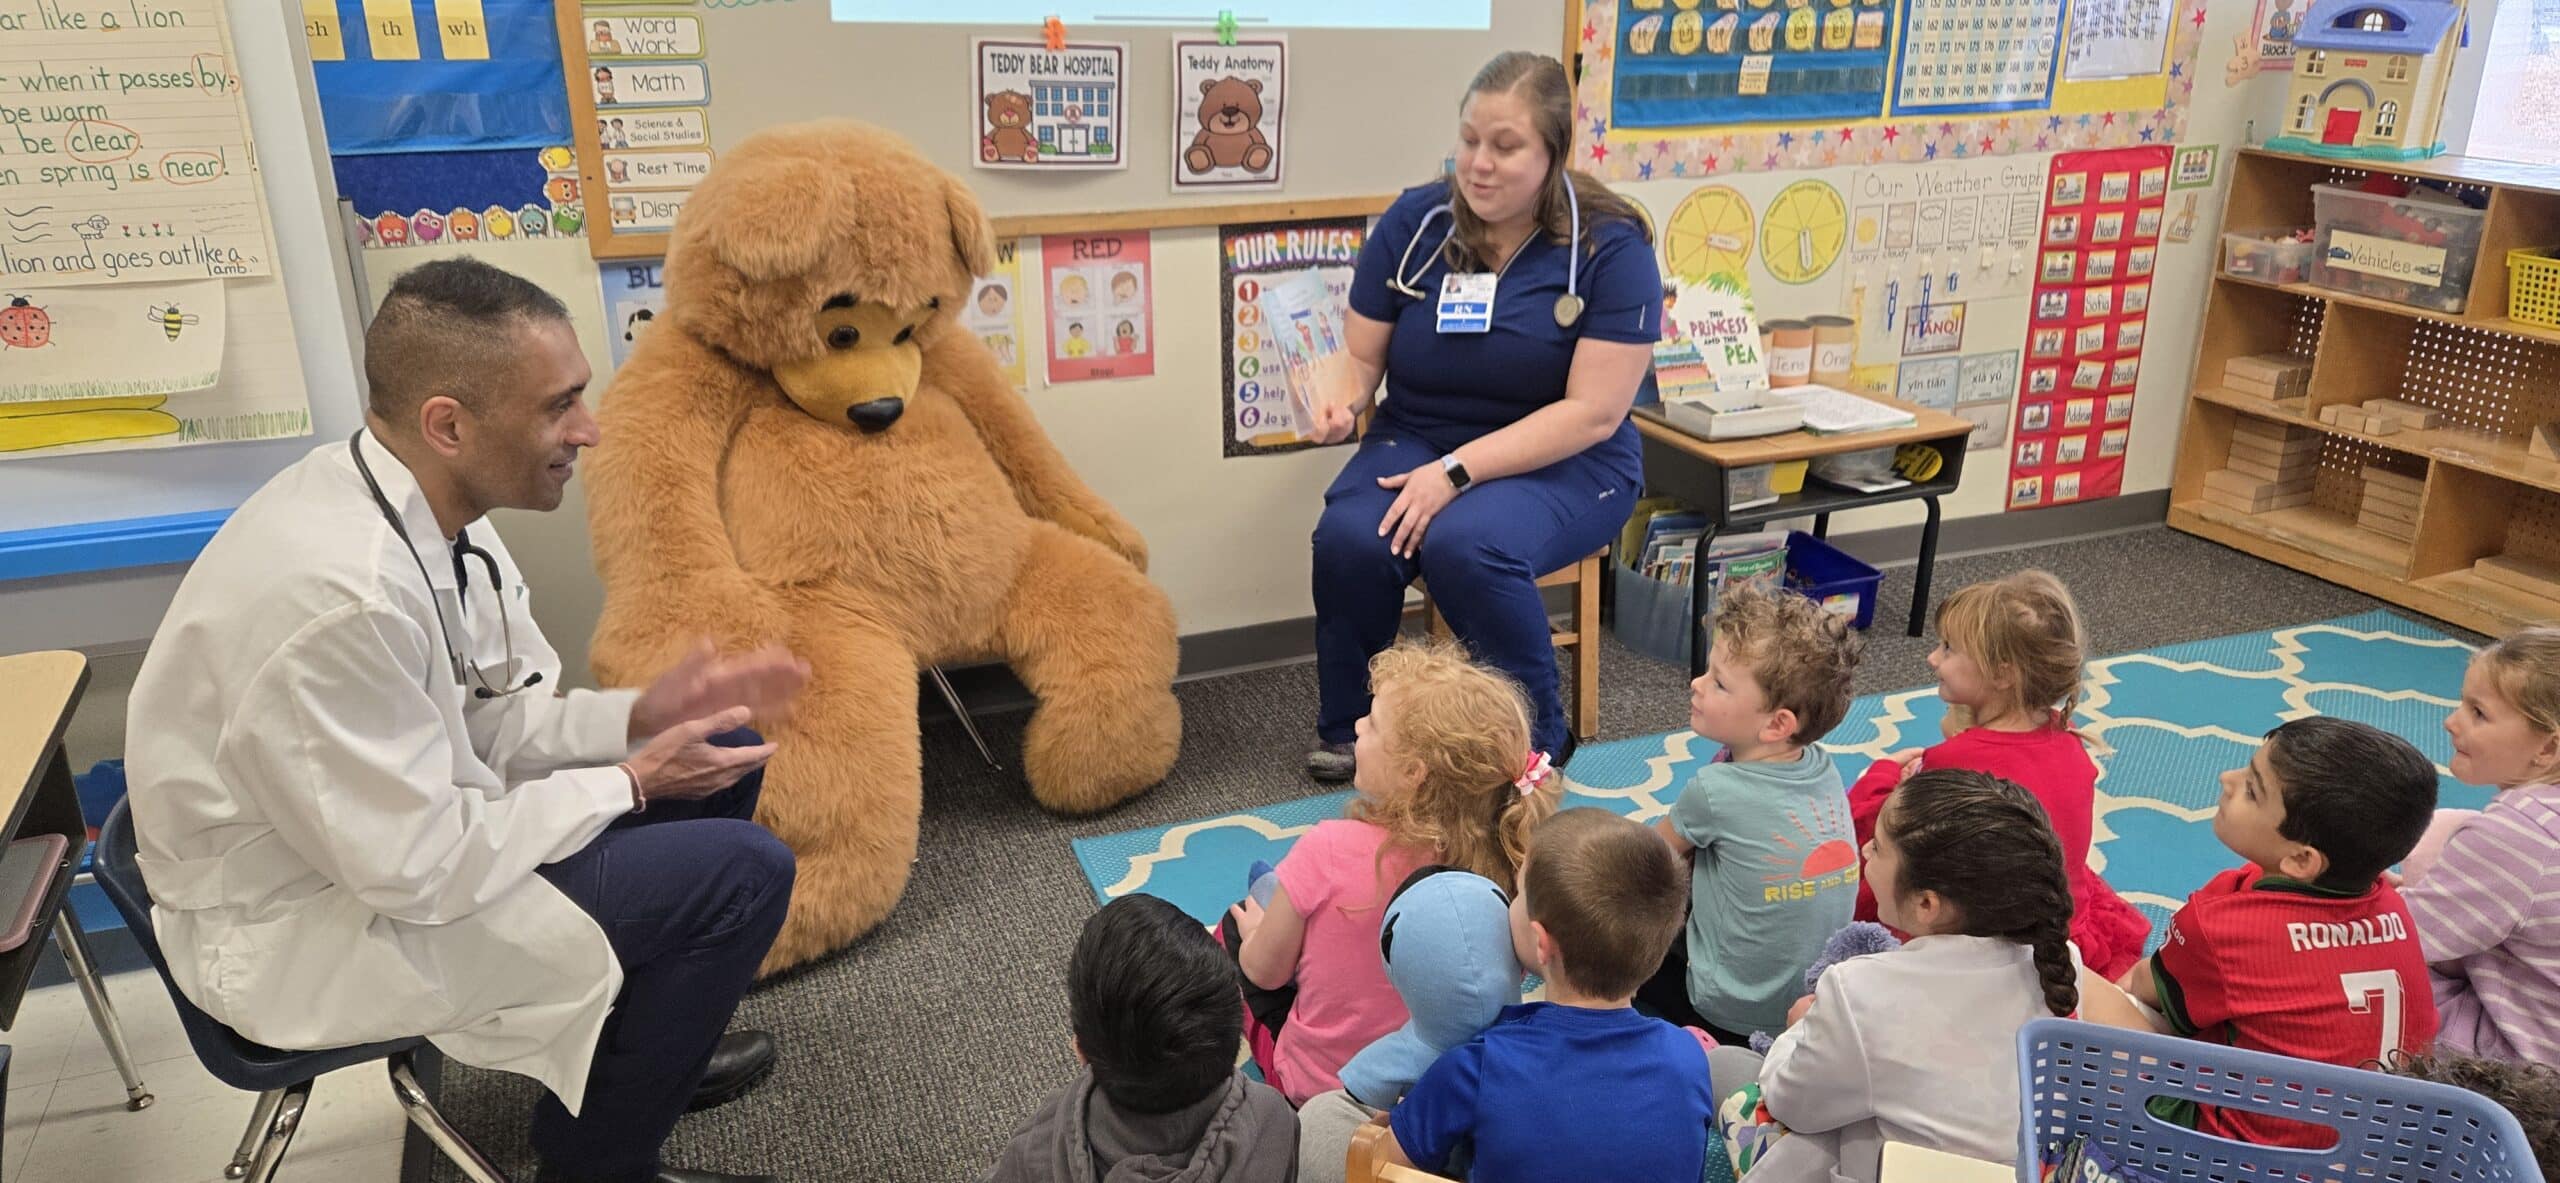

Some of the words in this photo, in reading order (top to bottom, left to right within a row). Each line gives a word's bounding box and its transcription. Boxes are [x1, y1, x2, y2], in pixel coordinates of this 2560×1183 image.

[37, 0, 87, 29] like
[101, 12, 120, 29] a
[131, 0, 185, 27] lion
[1912, 19, 1922, 32] 161
[1928, 19, 1939, 31] 162
[1943, 18, 1954, 31] 163
[1958, 18, 1968, 30] 164
[1973, 17, 1983, 30] 165
[1987, 17, 1998, 30] 166
[2002, 17, 2012, 29] 167
[2016, 16, 2027, 28] 168
[2031, 16, 2041, 28] 169
[2045, 15, 2055, 27] 170
[382, 21, 403, 36] th
[448, 21, 477, 36] wh
[624, 16, 677, 34] Word
[626, 37, 679, 54] Work
[1910, 42, 1920, 54] 171
[1925, 41, 1935, 53] 172
[1940, 41, 1950, 53] 173
[1954, 41, 1966, 52] 174
[1970, 40, 1980, 52] 175
[1984, 40, 1994, 52] 176
[1999, 39, 2009, 51] 177
[2262, 44, 2289, 57] Block
[990, 53, 1026, 74] TEDDY
[1030, 54, 1059, 75] BEAR
[1063, 55, 1115, 76] HOSPITAL
[1187, 55, 1219, 73] Teddy
[1224, 55, 1275, 73] Anatomy
[1906, 65, 1916, 77] 181
[1921, 64, 1932, 76] 182
[1936, 63, 1947, 76] 183
[1951, 63, 1962, 75] 184
[1966, 62, 1977, 74] 185
[1981, 61, 1991, 74] 186
[1996, 61, 2006, 73] 187
[2024, 60, 2034, 72] 189
[2038, 60, 2048, 71] 190
[19, 60, 83, 92] when
[91, 66, 110, 90] it
[119, 71, 195, 95] passes
[632, 73, 685, 92] Math
[1903, 87, 1914, 99] 191
[1919, 87, 1929, 98] 192
[1934, 86, 1945, 98] 193
[1948, 86, 1960, 97] 194
[1963, 85, 1974, 97] 195
[1978, 84, 1988, 96] 196
[2021, 82, 2031, 94] 199
[2033, 81, 2046, 94] 200
[41, 104, 109, 122] warm
[635, 119, 674, 129] Science
[16, 124, 56, 153] be
[630, 132, 660, 142] Social
[663, 130, 702, 141] Studies
[41, 158, 118, 190] spring
[129, 158, 150, 179] is
[637, 162, 668, 174] Rest
[673, 161, 706, 174] Time
[1865, 172, 1903, 198] Our
[1915, 167, 1993, 197] Weather
[2000, 162, 2044, 193] Graph
[2096, 220, 2118, 240] Noah
[1, 244, 46, 274] lion
[52, 238, 95, 271] and
[103, 252, 152, 278] goes
[159, 243, 191, 265] out
[192, 235, 223, 263] like
[228, 247, 241, 261] a
[1072, 237, 1122, 260] RED
[1234, 233, 1281, 269] OUR
[1286, 230, 1353, 263] RULES
[2350, 243, 2412, 274] Vehicles
[1454, 304, 1473, 315] RN
[1709, 310, 1723, 318] THE
[1723, 335, 1738, 344] THE
[1725, 343, 1758, 367] PEA
[1776, 355, 1806, 372] Tens
[2075, 366, 2093, 384] Zoe
[1264, 387, 1286, 402] help
[1264, 412, 1278, 425] do
[1764, 881, 1816, 903] RISE
[2287, 911, 2407, 952] RONALDO
[2340, 968, 2406, 1073] 7
